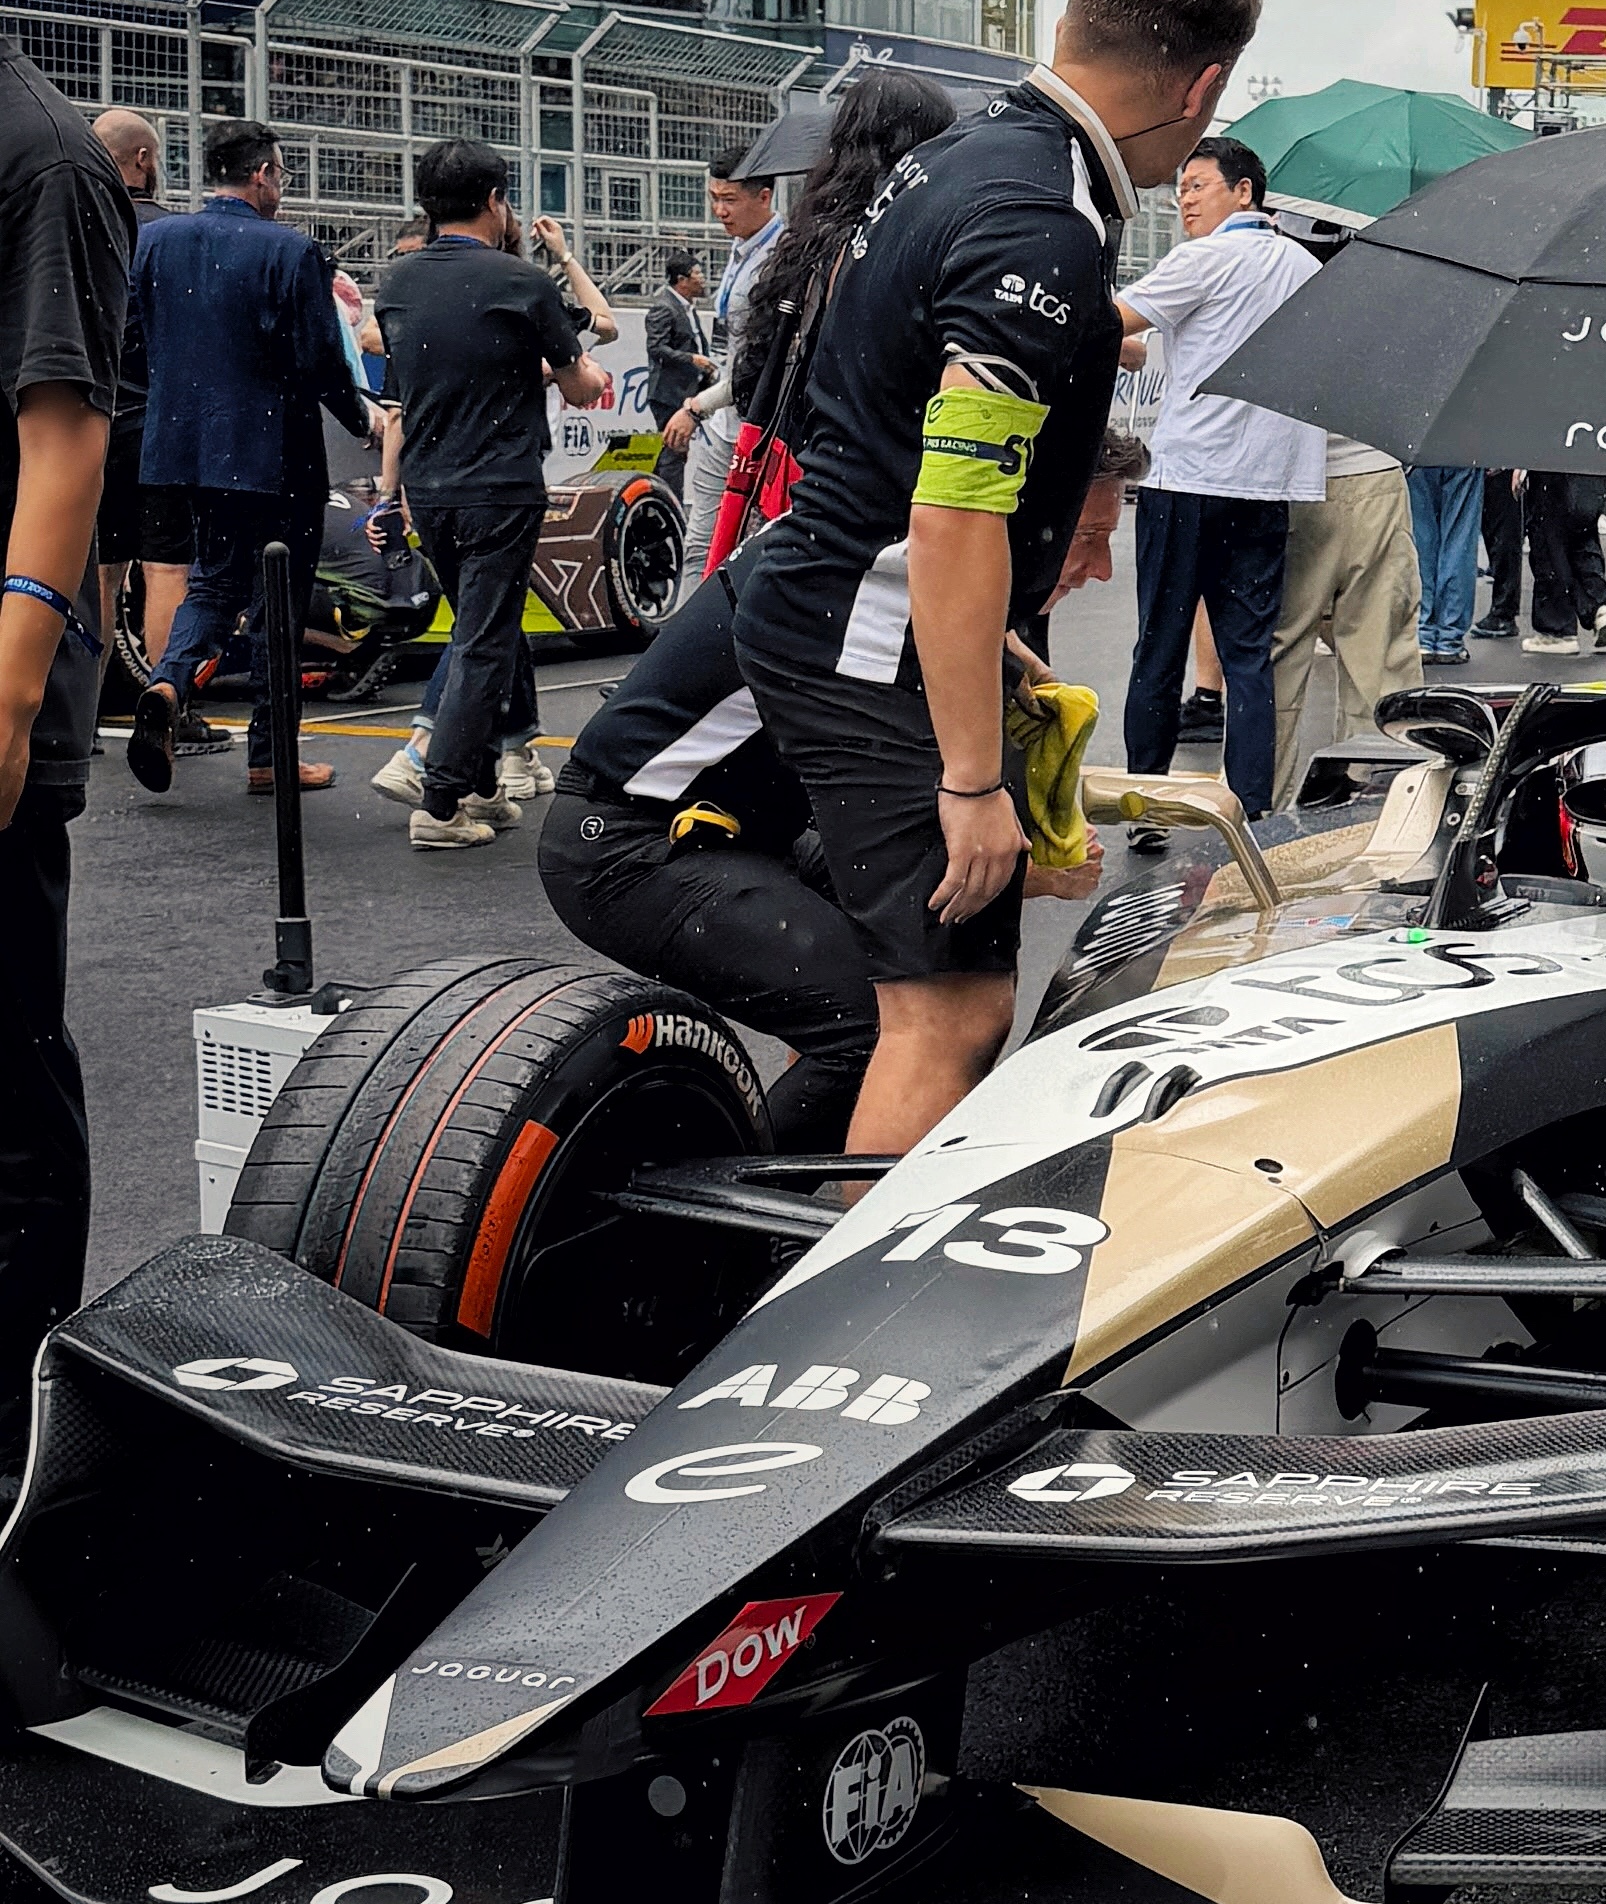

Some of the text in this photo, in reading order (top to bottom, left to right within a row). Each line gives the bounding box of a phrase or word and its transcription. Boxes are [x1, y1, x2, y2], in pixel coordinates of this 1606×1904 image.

[1029, 282, 1071, 325] tcs
[881, 1203, 1110, 1275] 13
[318, 1376, 637, 1441] SAPPHIRE
[677, 1363, 932, 1425] ABB
[1163, 1470, 1542, 1496] SAPPHIRE
[694, 1605, 808, 1707] DOW
